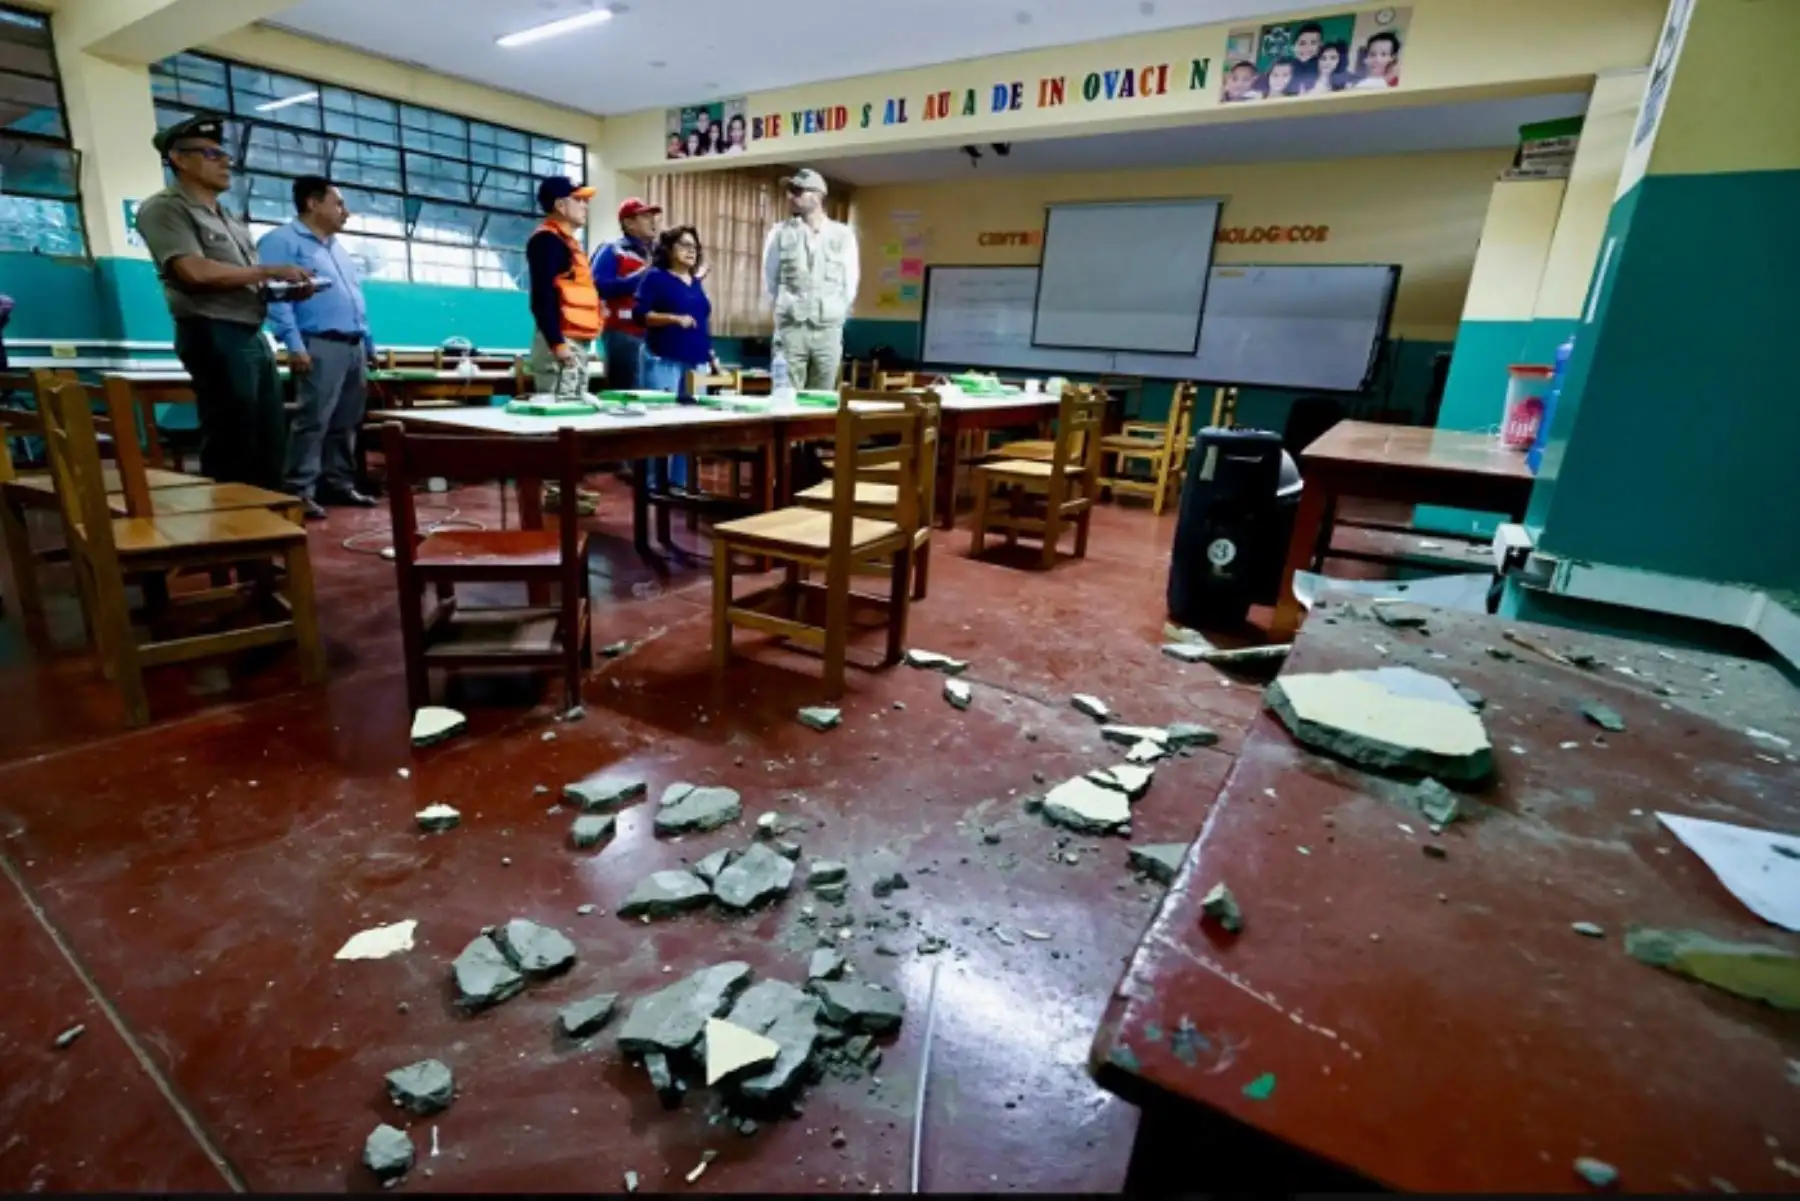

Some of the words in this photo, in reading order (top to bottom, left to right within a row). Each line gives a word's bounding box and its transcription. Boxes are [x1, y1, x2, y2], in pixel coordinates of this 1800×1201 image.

[883, 98, 908, 125] AL
[922, 88, 976, 121] AUA
[992, 81, 1024, 113] DE
[1037, 57, 1210, 108] INOVACIN
